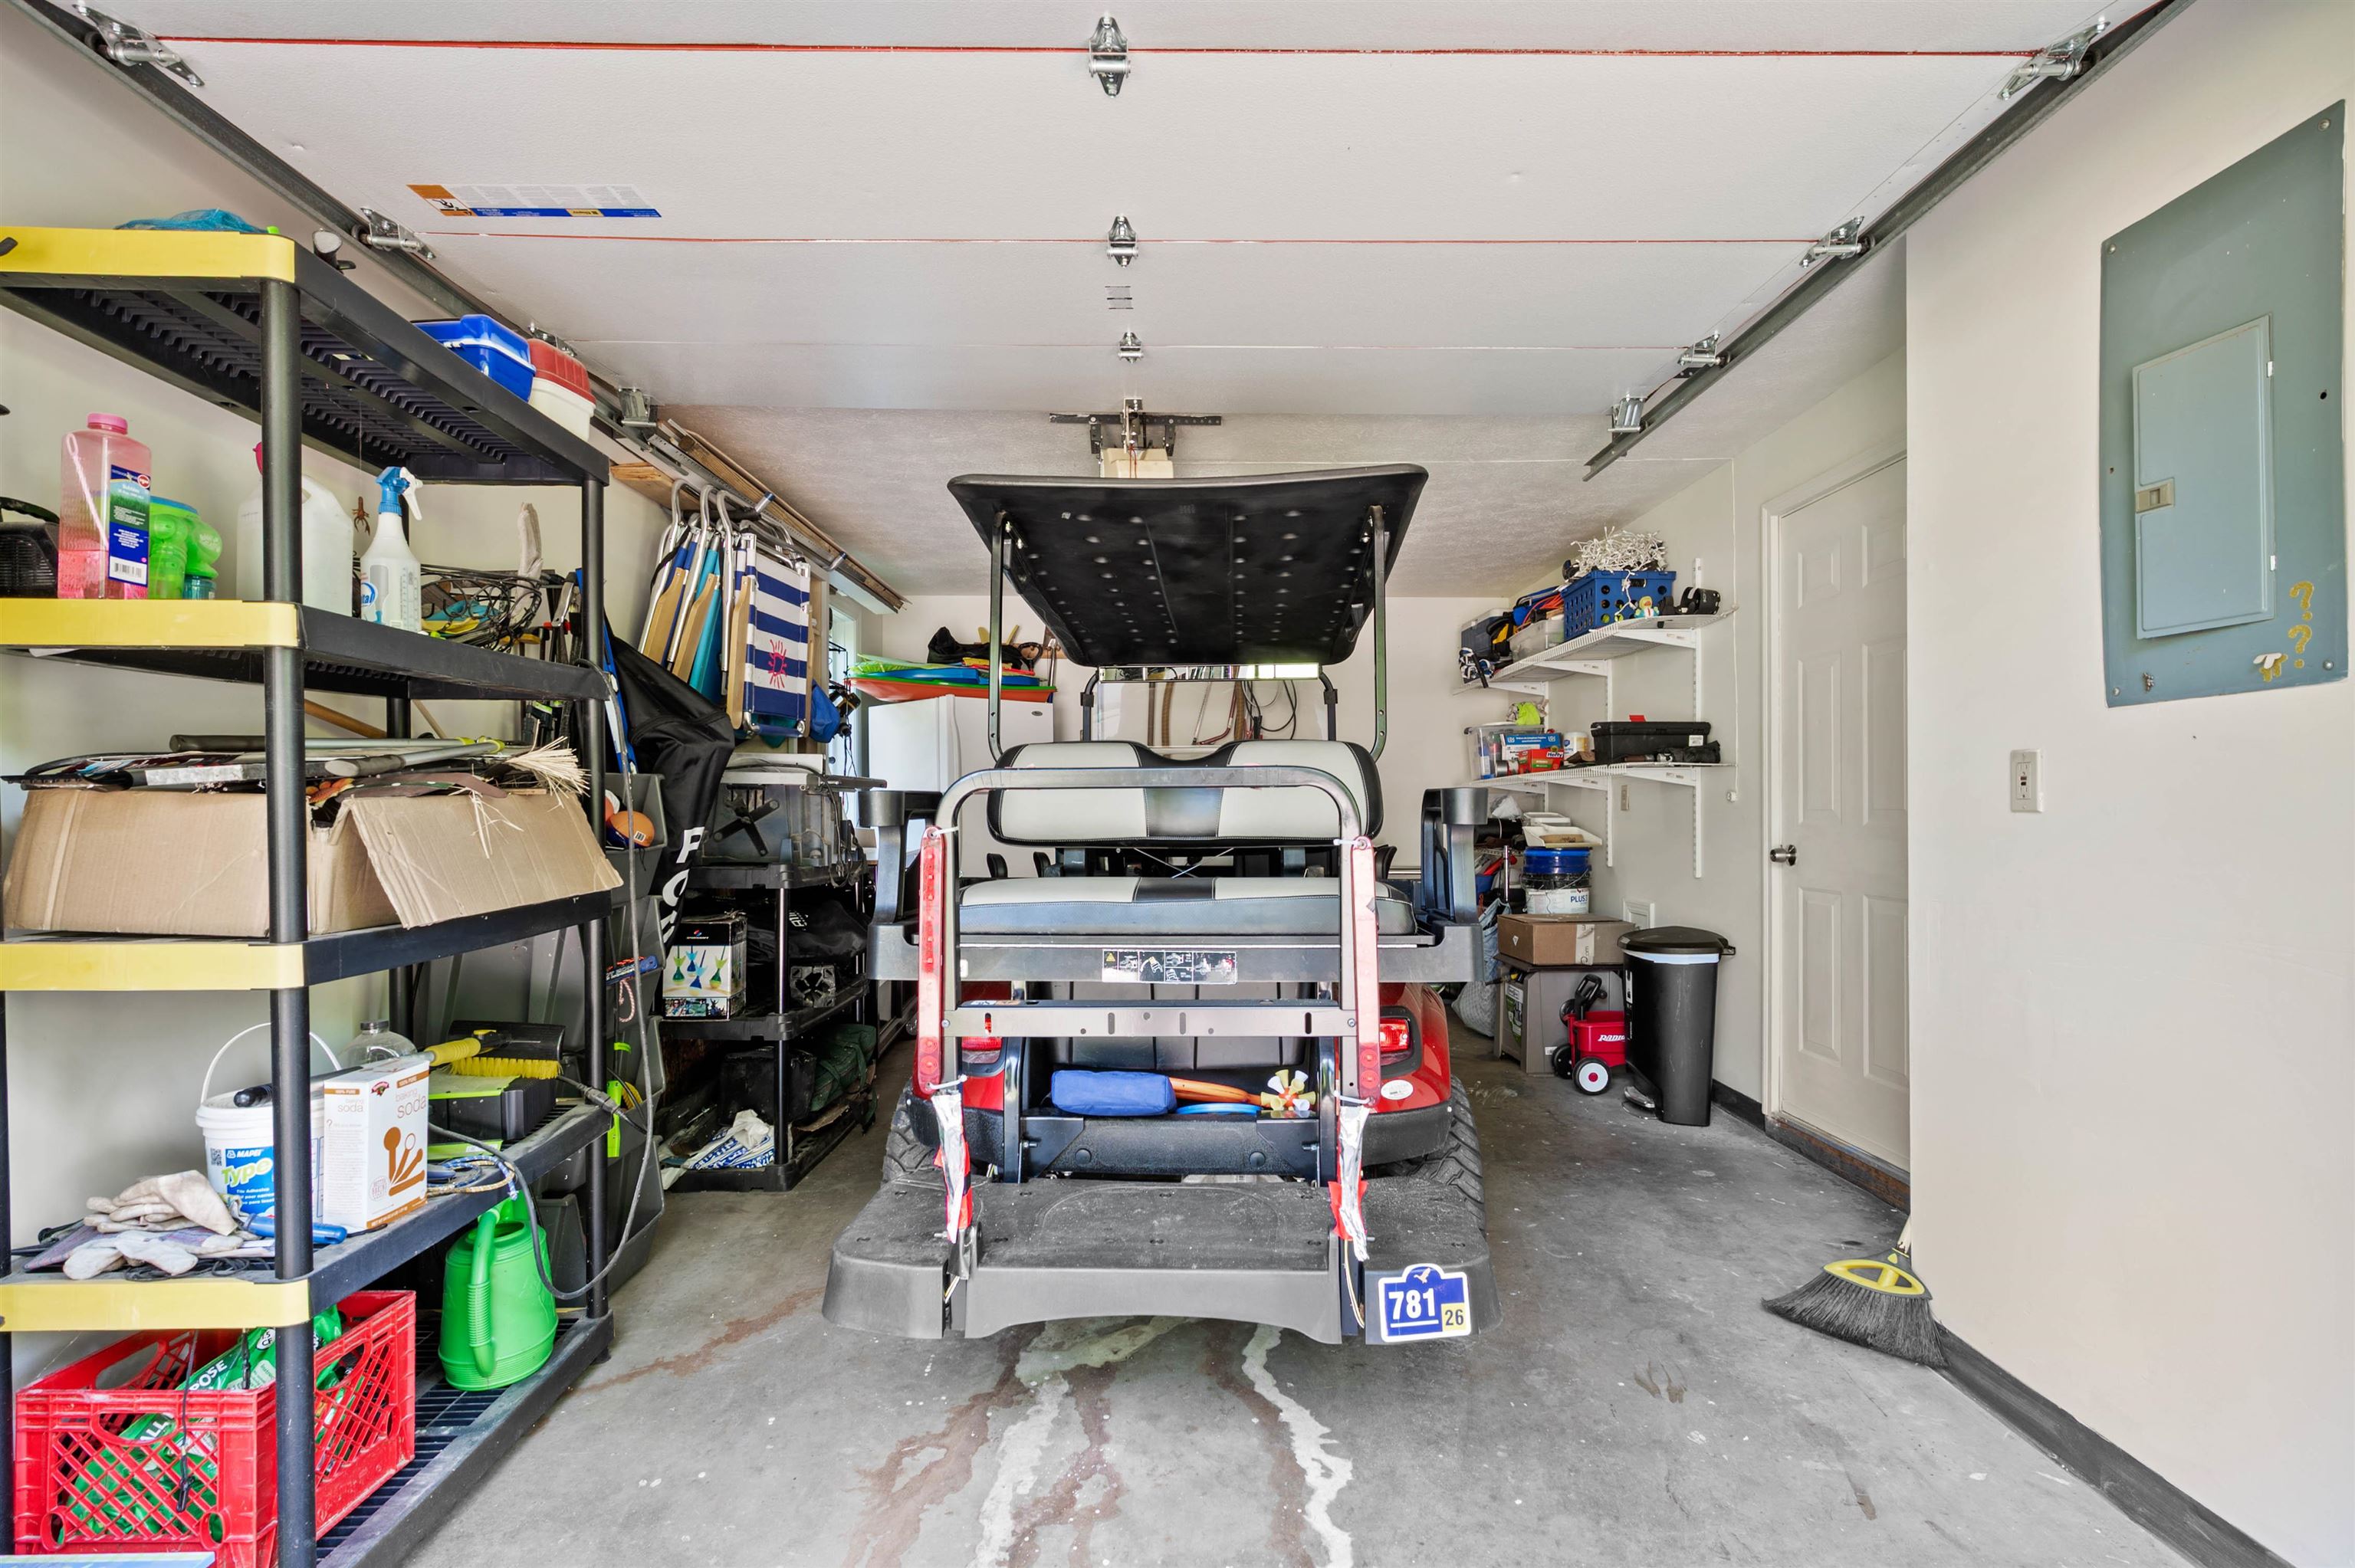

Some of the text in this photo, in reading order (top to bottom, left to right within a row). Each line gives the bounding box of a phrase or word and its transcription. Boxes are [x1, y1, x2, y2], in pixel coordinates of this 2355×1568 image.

[337, 1104, 364, 1113] soda
[397, 1093, 427, 1119] soda
[237, 1150, 262, 1158] MAPEI
[222, 1158, 274, 1188] Type
[1388, 1288, 1436, 1320] 781
[1444, 1309, 1464, 1326] 26
